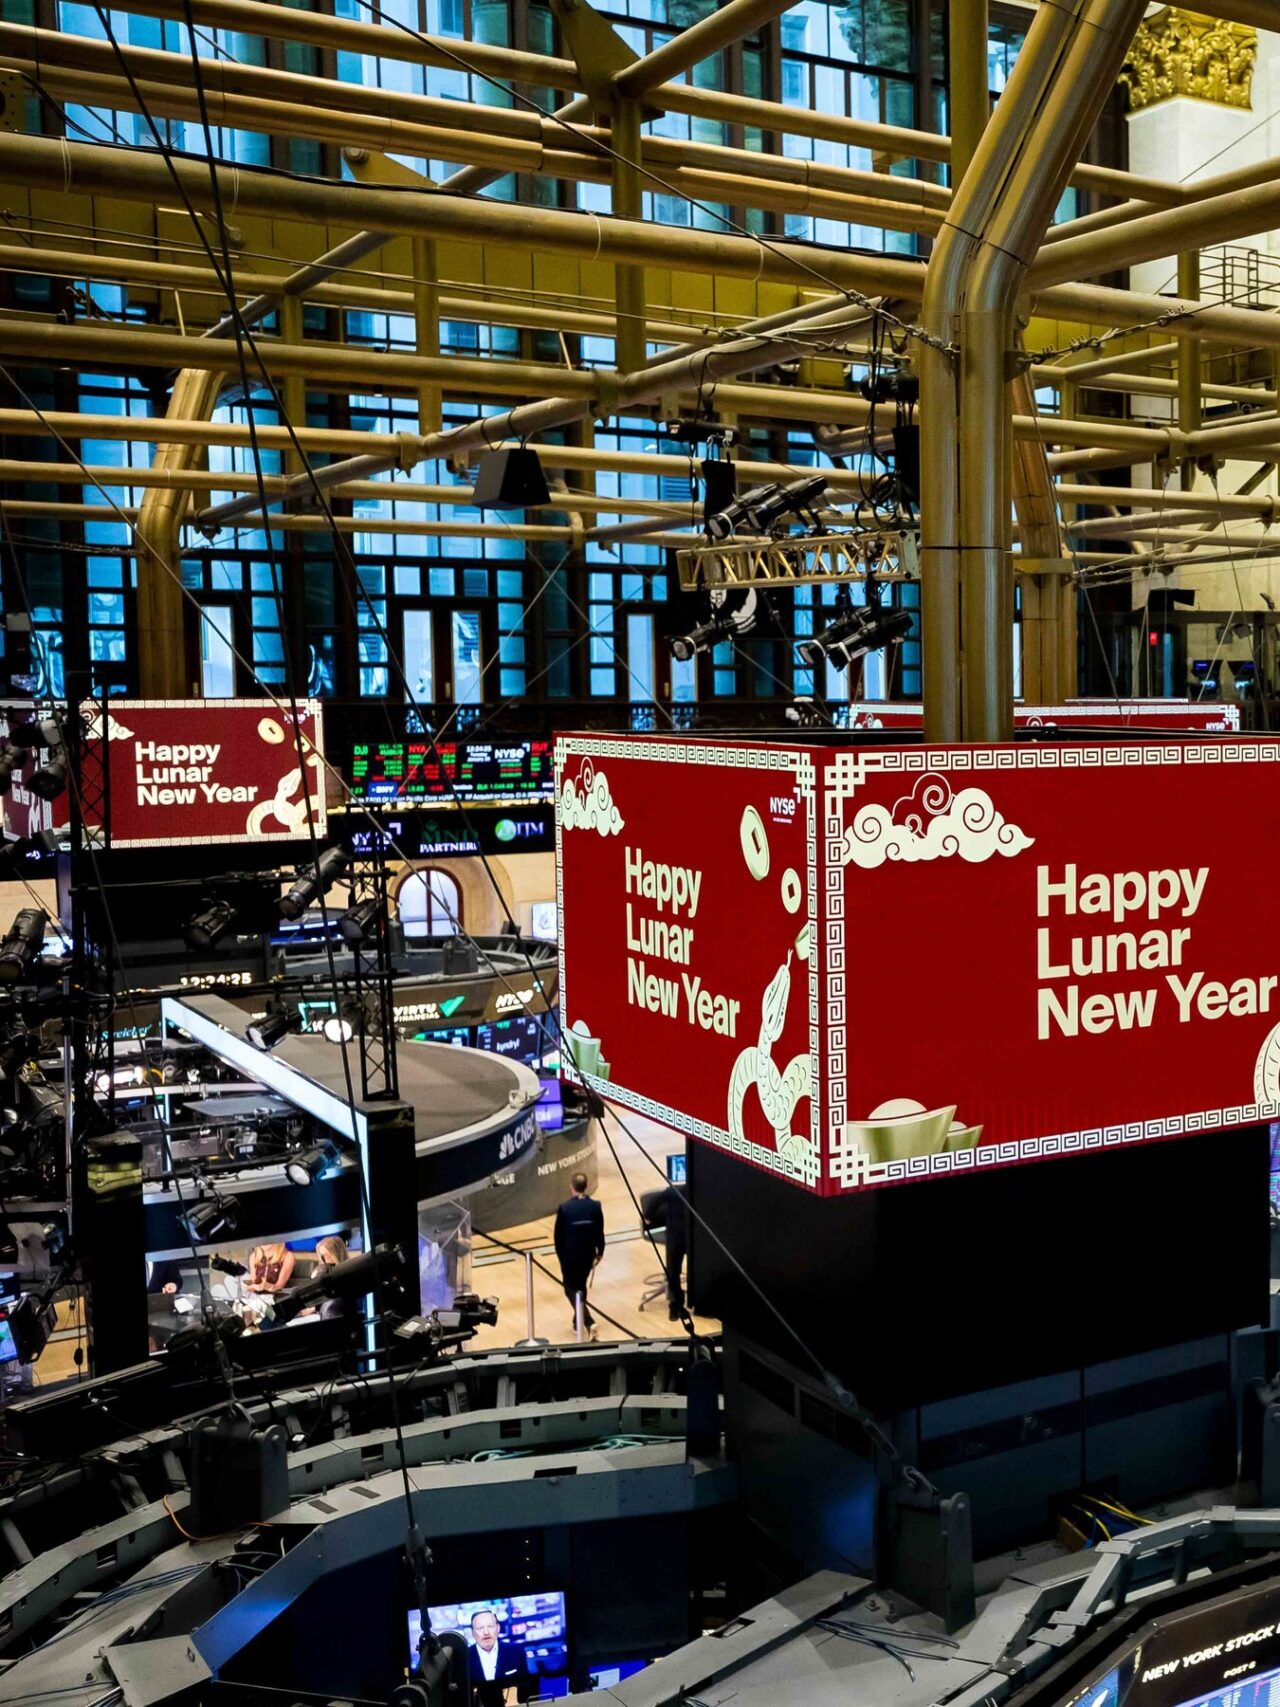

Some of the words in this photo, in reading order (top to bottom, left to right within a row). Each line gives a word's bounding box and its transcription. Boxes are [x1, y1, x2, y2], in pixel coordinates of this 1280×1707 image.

[135, 741, 221, 765] Happy
[136, 763, 213, 784] Lunar
[137, 785, 197, 806] New
[200, 783, 258, 803] Year
[420, 842, 478, 853] PARTNER
[625, 846, 702, 918] Happy
[1036, 863, 1209, 922] Happy
[626, 903, 694, 966] Lunar
[1037, 927, 1191, 979] Lunar
[627, 958, 679, 1019] New
[681, 972, 740, 1038] Year
[1038, 986, 1157, 1040] New
[1165, 972, 1278, 1023] Year
[1142, 1660, 1180, 1683] NEW
[1182, 1643, 1224, 1669] YORK
[1225, 1625, 1275, 1653] STOCK
[1224, 1665, 1248, 1679] POST
